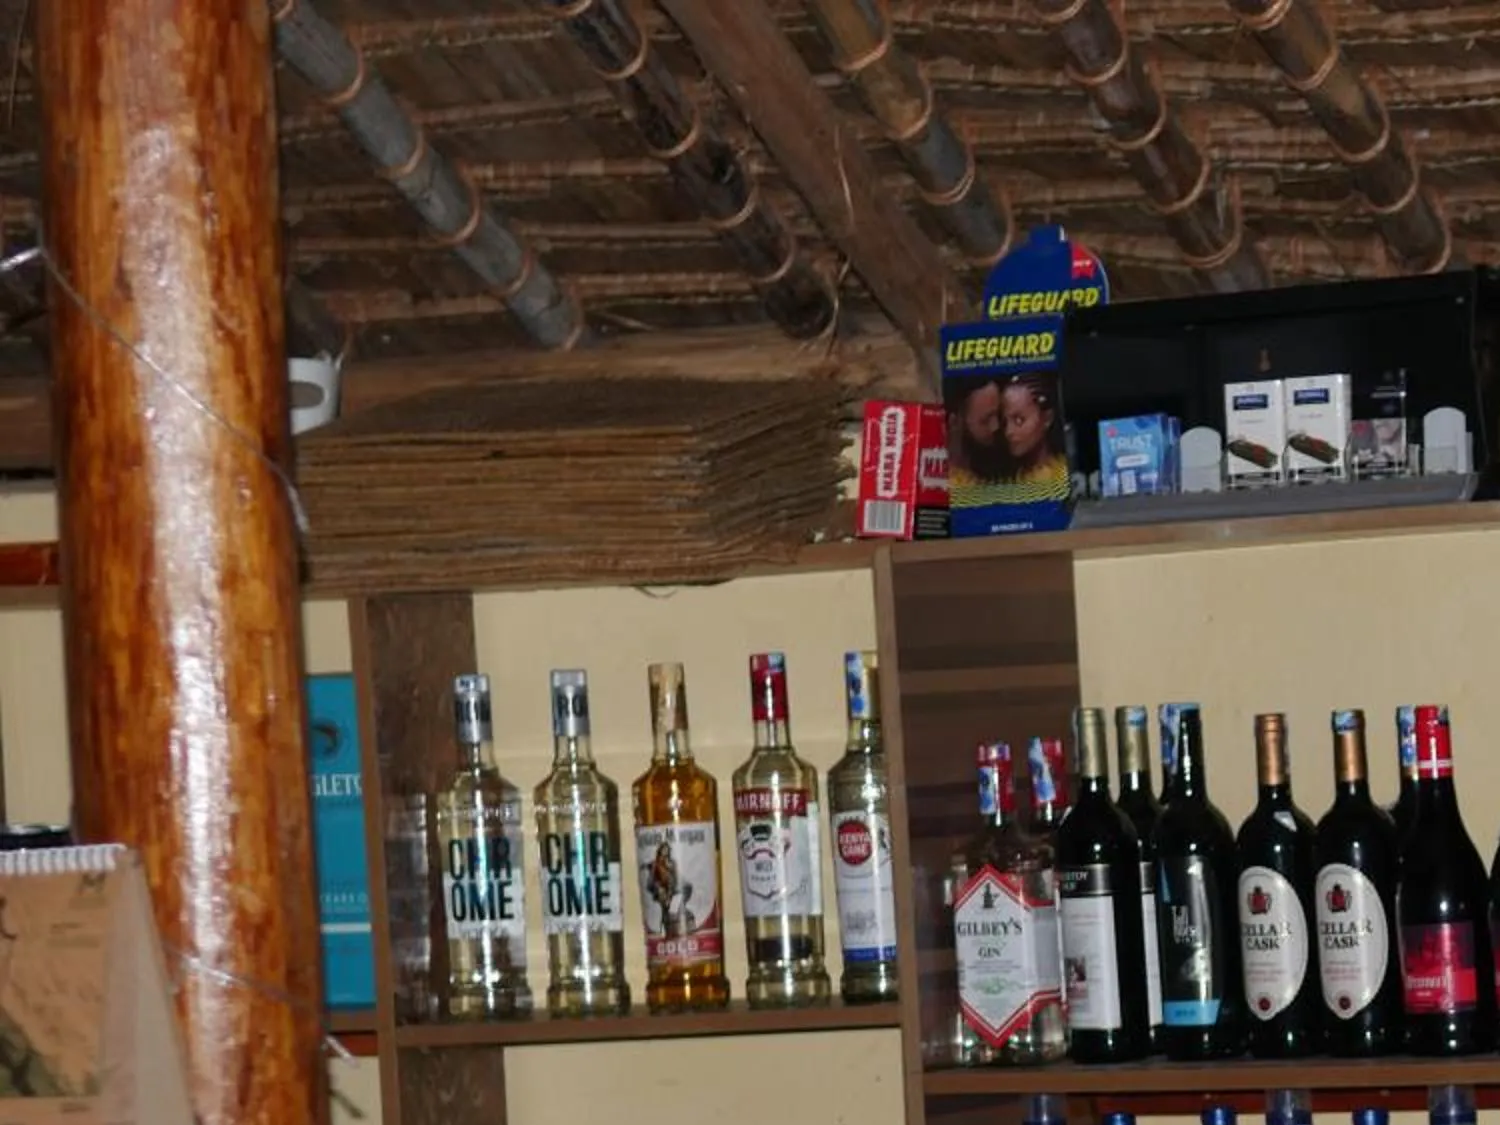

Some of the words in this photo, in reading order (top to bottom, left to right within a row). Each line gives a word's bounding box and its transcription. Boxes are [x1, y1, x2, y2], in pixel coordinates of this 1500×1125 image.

[989, 287, 1099, 319] LIFEGUARD
[946, 331, 1054, 362] LIFEGUARD
[1107, 432, 1157, 451] TRUST
[957, 917, 1023, 937] GILBEY'S
[1246, 937, 1280, 951] CASK
[1324, 934, 1360, 949] CASK
[977, 945, 1001, 959] GIN
